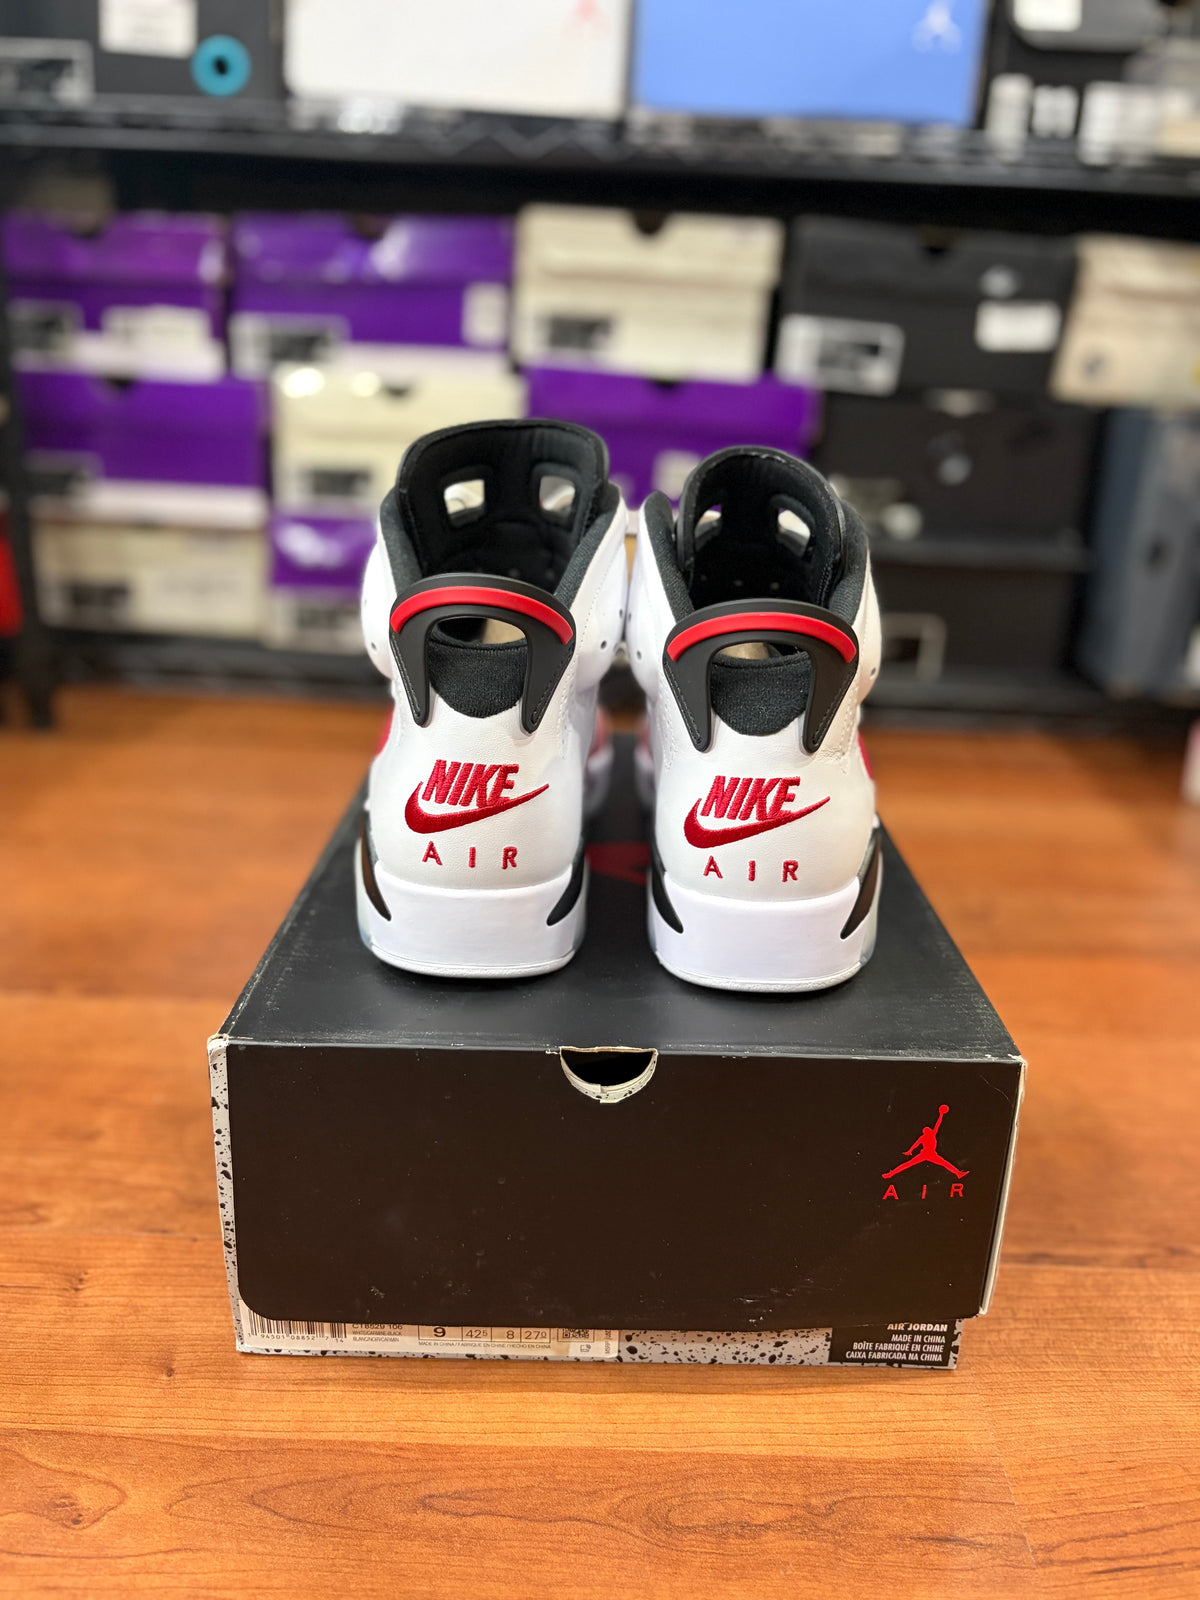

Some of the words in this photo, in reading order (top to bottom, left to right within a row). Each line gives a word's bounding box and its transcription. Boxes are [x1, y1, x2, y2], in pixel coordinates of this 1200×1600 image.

[421, 759, 519, 809] NIKE
[700, 775, 800, 821] NIKE
[421, 841, 518, 870] AIR
[703, 855, 799, 882] AIR
[882, 1183, 964, 1200] AIR
[433, 1326, 446, 1338] 9
[506, 1330, 515, 1340] 8
[887, 1322, 905, 1331] AIR
[907, 1323, 948, 1332] JORDAN
[891, 1334, 912, 1342] MADE
[923, 1335, 946, 1344] CHINA
[845, 1350, 866, 1359] CAIXA
[868, 1351, 907, 1360] FABRICADA
[908, 1352, 919, 1360] NA
[920, 1353, 942, 1362] CHINA
[911, 1344, 921, 1352] EN
[922, 1344, 944, 1353] CHINE
